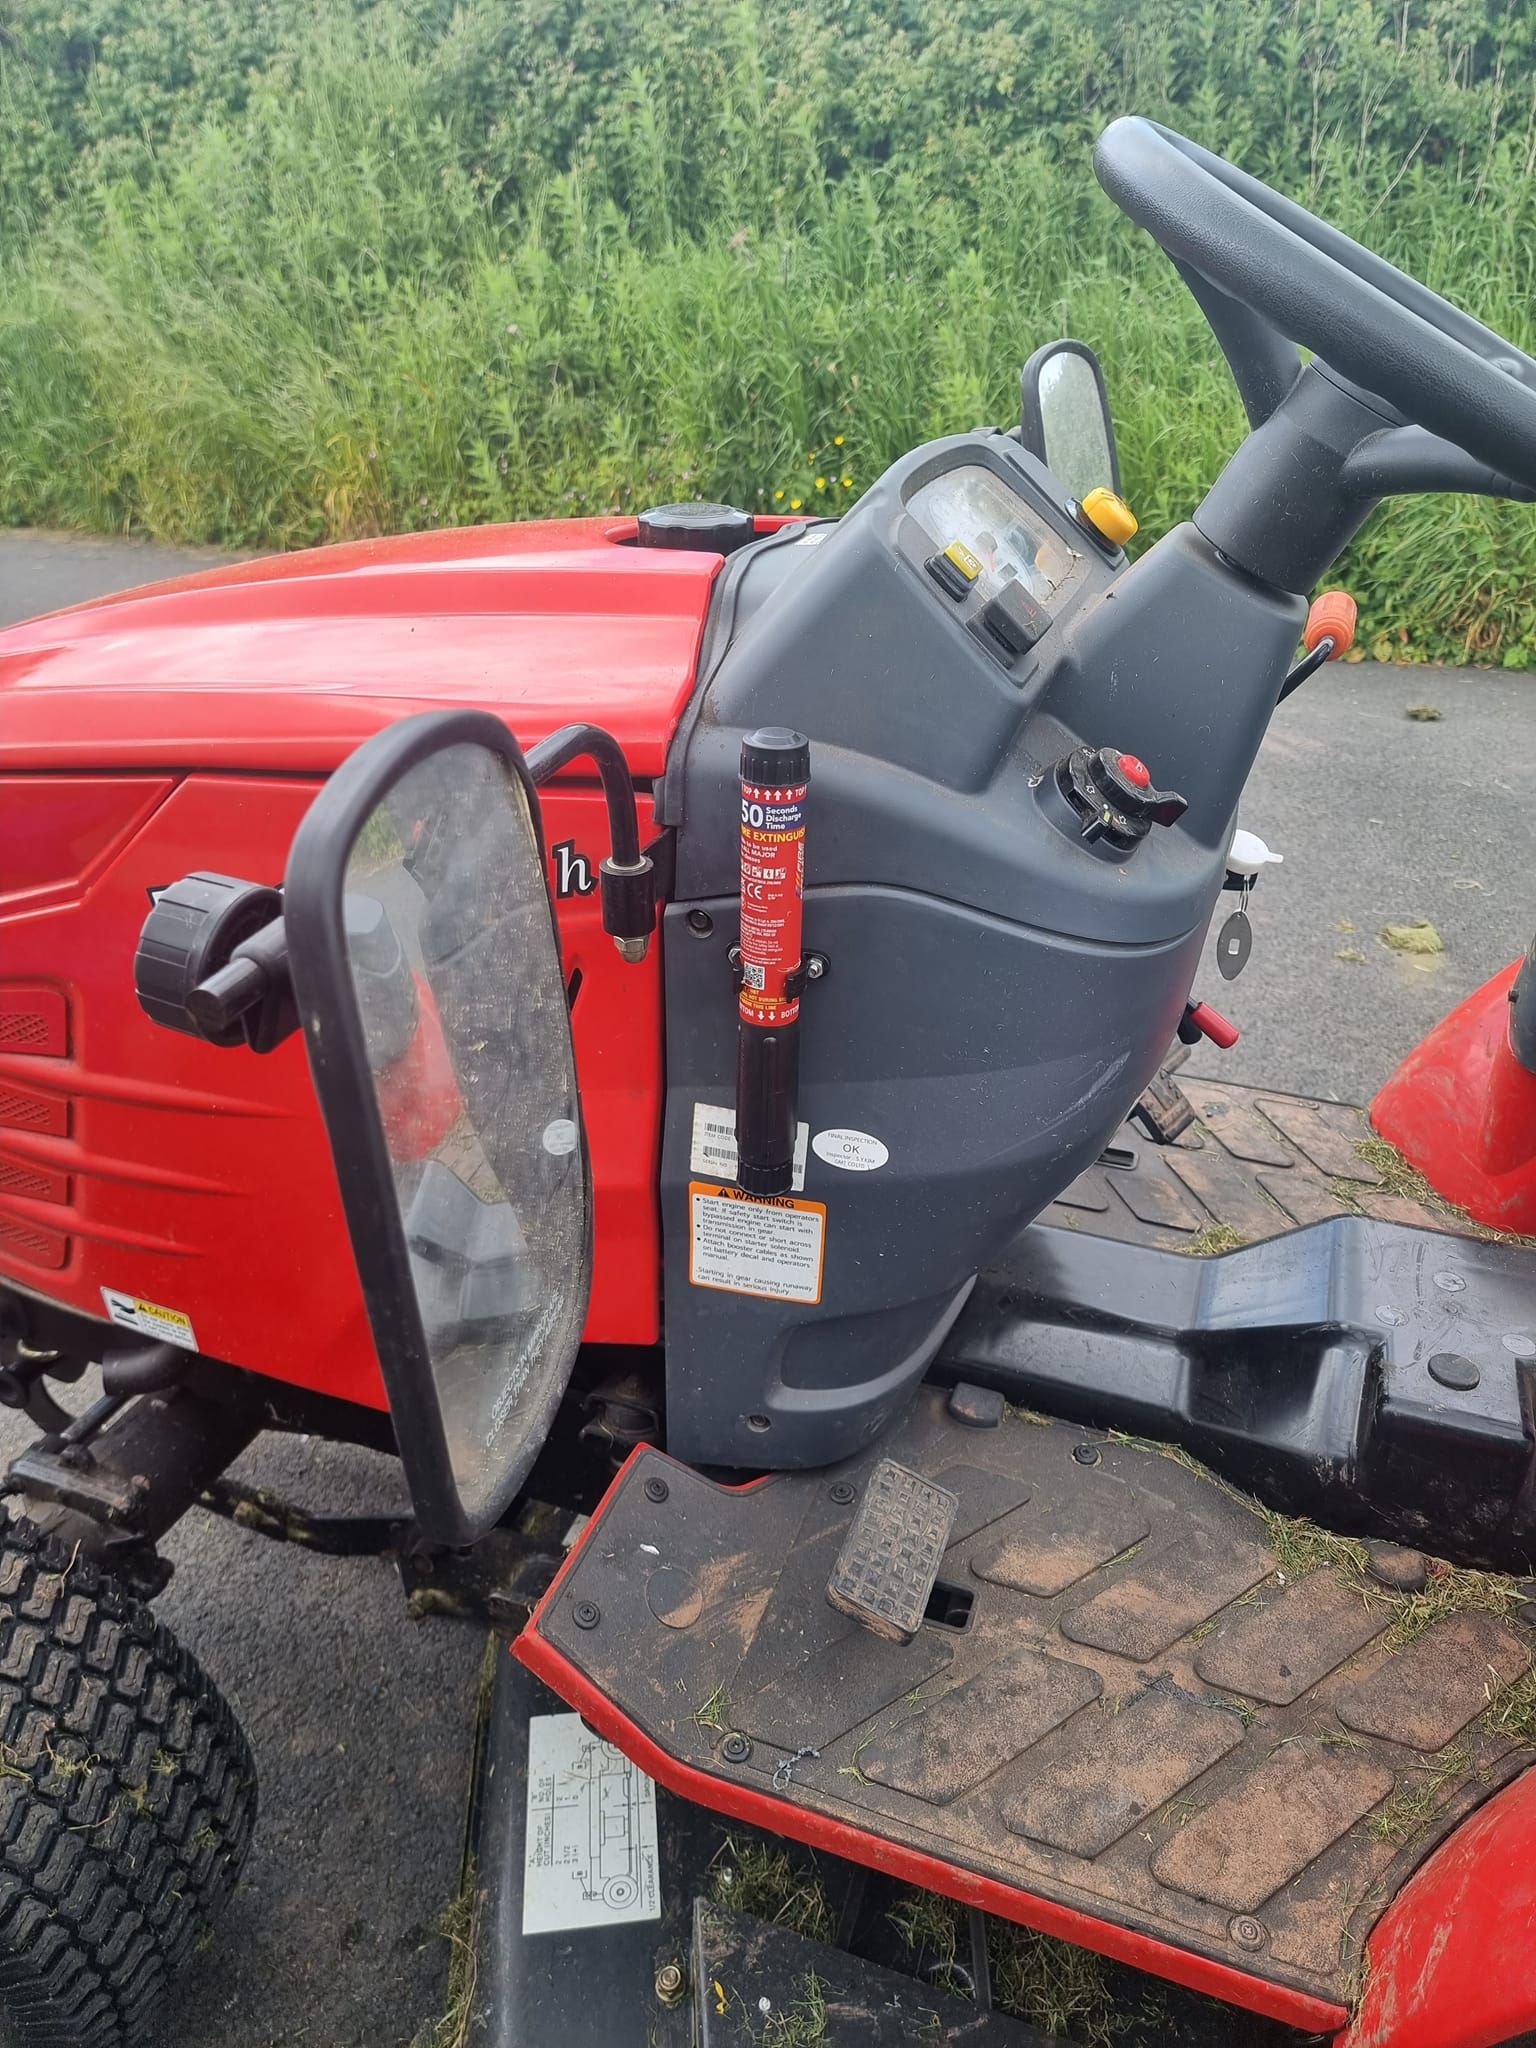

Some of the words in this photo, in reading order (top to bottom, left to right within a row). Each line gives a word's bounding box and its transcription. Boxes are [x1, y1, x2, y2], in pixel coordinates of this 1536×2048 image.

[741, 798, 764, 828] 50
[765, 804, 798, 815] Seconds
[764, 822, 786, 830] Time
[753, 829, 805, 843] EXTINGUIS
[752, 849, 776, 858] MAJOR
[780, 1002, 799, 1019] BOTTO
[827, 1132, 843, 1141] FINAL
[844, 1135, 878, 1146] INSPECTION
[842, 1143, 861, 1154] OK
[702, 1197, 720, 1206] Start
[721, 1202, 746, 1210] engine
[747, 1206, 763, 1214] only
[766, 1208, 783, 1217] from
[784, 1213, 819, 1223] operators
[729, 1209, 750, 1219] safety
[772, 1217, 795, 1226] switch
[702, 1211, 735, 1222] bypassed
[737, 1218, 762, 1227] engine
[779, 1224, 796, 1233] start
[702, 1218, 746, 1231] transmission
[702, 1231, 731, 1241] terminal
[745, 1239, 768, 1248] starter
[728, 1230, 757, 1239] connect
[769, 1235, 787, 1245] short
[789, 1240, 813, 1249] across
[702, 1237, 725, 1247] Attach
[727, 1242, 754, 1251] booster
[755, 1249, 778, 1257] cables
[790, 1253, 814, 1262] shown
[713, 1245, 739, 1257] battery
[740, 1251, 760, 1260] decal
[761, 1255, 775, 1263] and
[776, 1259, 811, 1269] operators
[697, 1265, 725, 1278] Starting
[735, 1273, 752, 1282] gear
[753, 1278, 781, 1288] causing
[782, 1282, 813, 1292] runaway
[697, 1273, 710, 1281] can
[712, 1276, 732, 1284] result
[742, 1282, 768, 1291] serious
[537, 1825, 544, 1836] OF
[536, 1838, 544, 1868] HEIGHT
[543, 1850, 551, 1866] CUT
[646, 1853, 656, 1898] CLEARANCE
